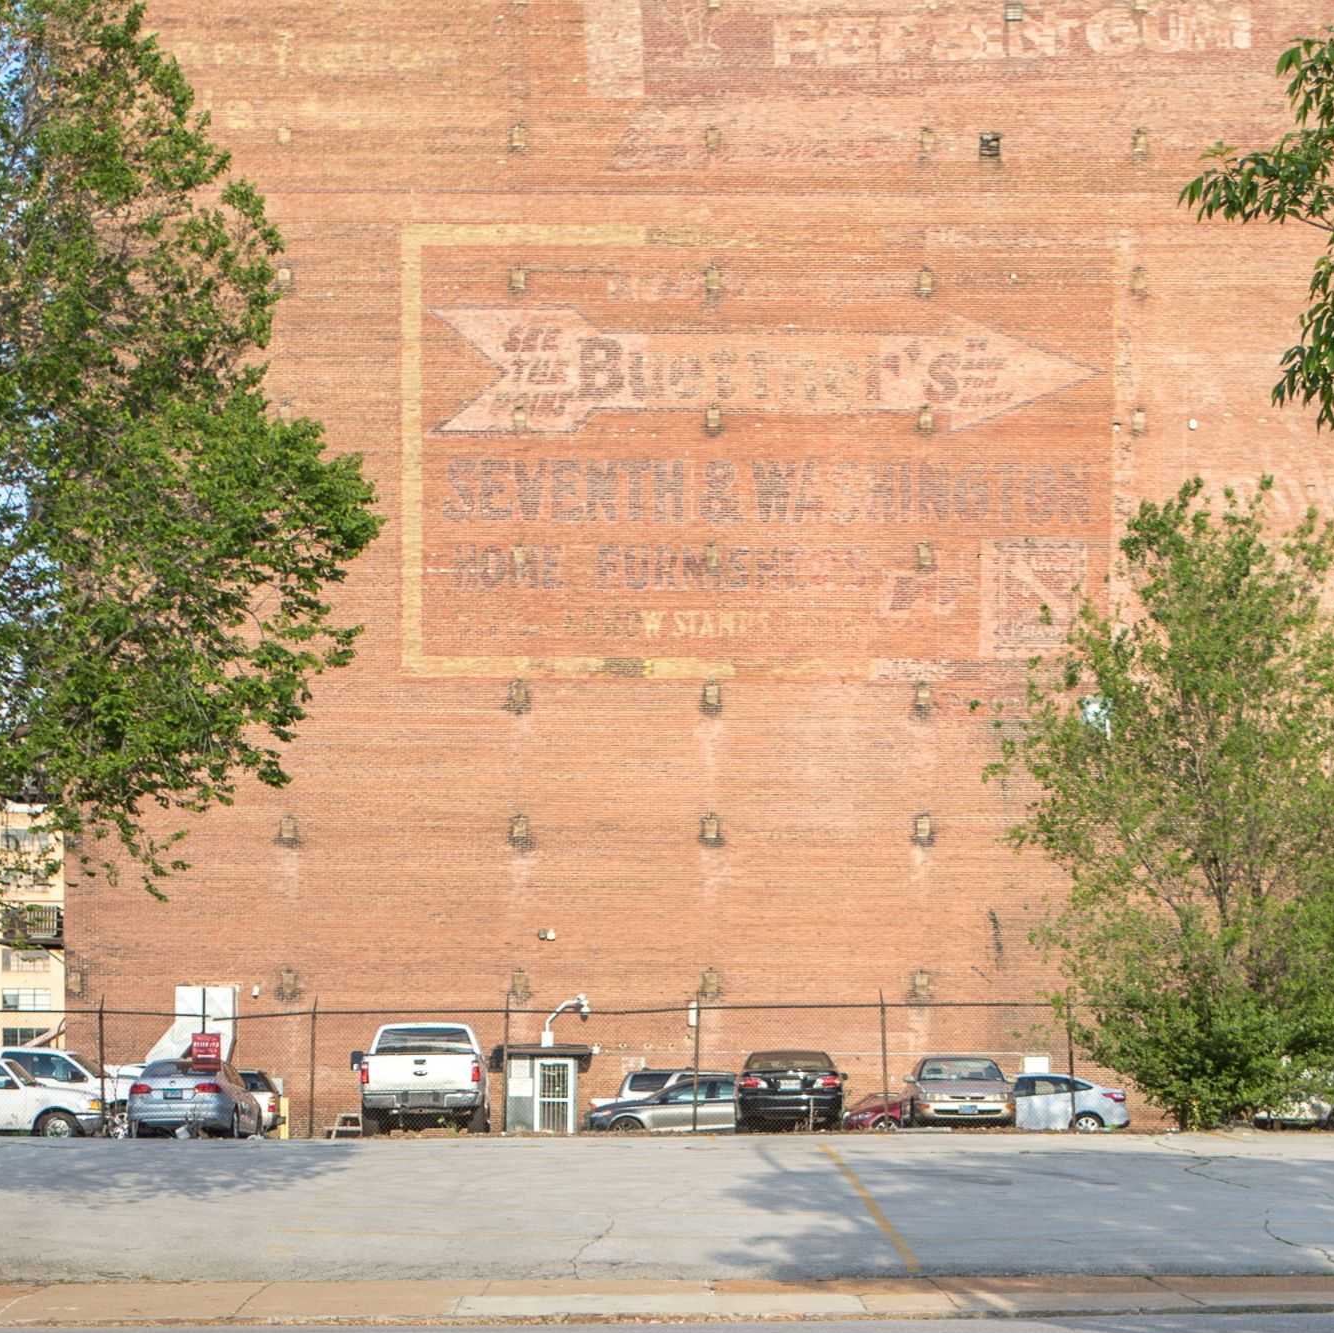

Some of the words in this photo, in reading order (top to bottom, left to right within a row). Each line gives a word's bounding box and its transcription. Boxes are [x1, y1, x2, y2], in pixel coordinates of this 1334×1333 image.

[442, 458, 685, 523] SEVENTH
[700, 459, 742, 523] &
[752, 458, 1091, 525] WASHINGTON
[452, 544, 565, 589] HOME
